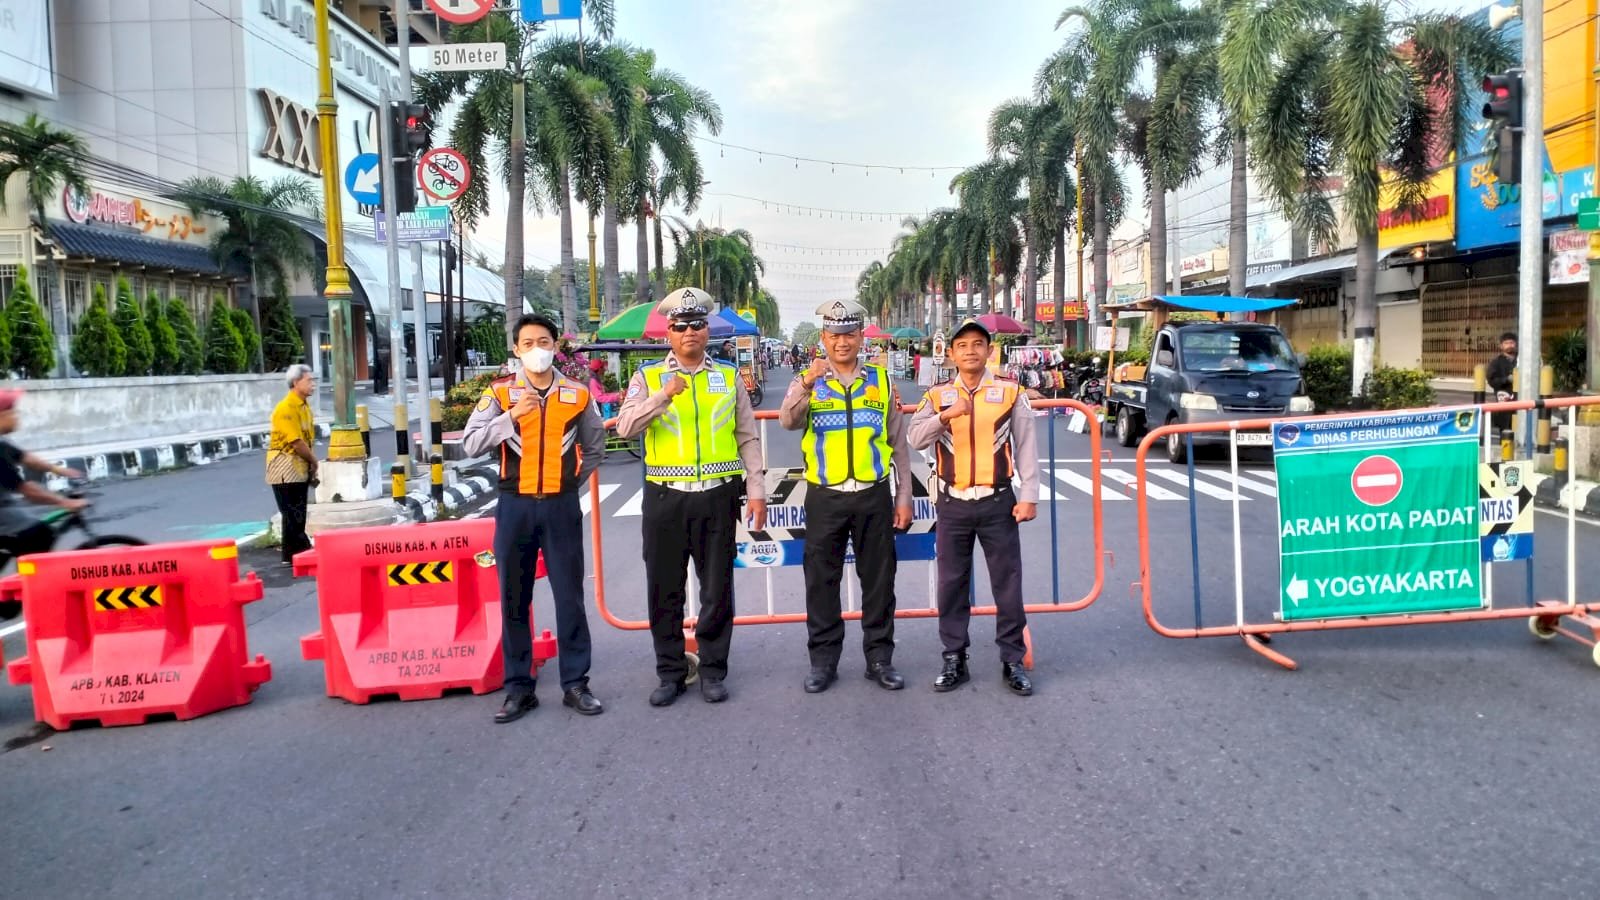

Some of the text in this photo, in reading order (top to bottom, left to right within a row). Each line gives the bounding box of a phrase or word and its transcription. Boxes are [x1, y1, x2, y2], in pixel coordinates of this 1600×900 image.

[434, 48, 498, 66] 50 Meter
[397, 211, 430, 221] AWASAN
[1304, 412, 1449, 432] PEMERINTAH KABUPATEN KLATEN
[1313, 425, 1439, 445] DINAS PERHUBUNGAN
[748, 505, 789, 529] PTUHI
[1282, 506, 1476, 538] ARAH KOTA PADAT
[365, 536, 469, 556] DISHUB KAB. KATEN
[750, 543, 778, 555] AQUA
[71, 560, 178, 580] DISHUB KAB. KLATEN
[1314, 568, 1474, 598] YOGYAKARTA
[369, 645, 476, 665] APBD KAB. KLATEN
[105, 674, 132, 688] KAB.
[136, 669, 181, 685] KLATEN
[398, 663, 441, 678] TA 2024
[118, 690, 145, 703] 2024
